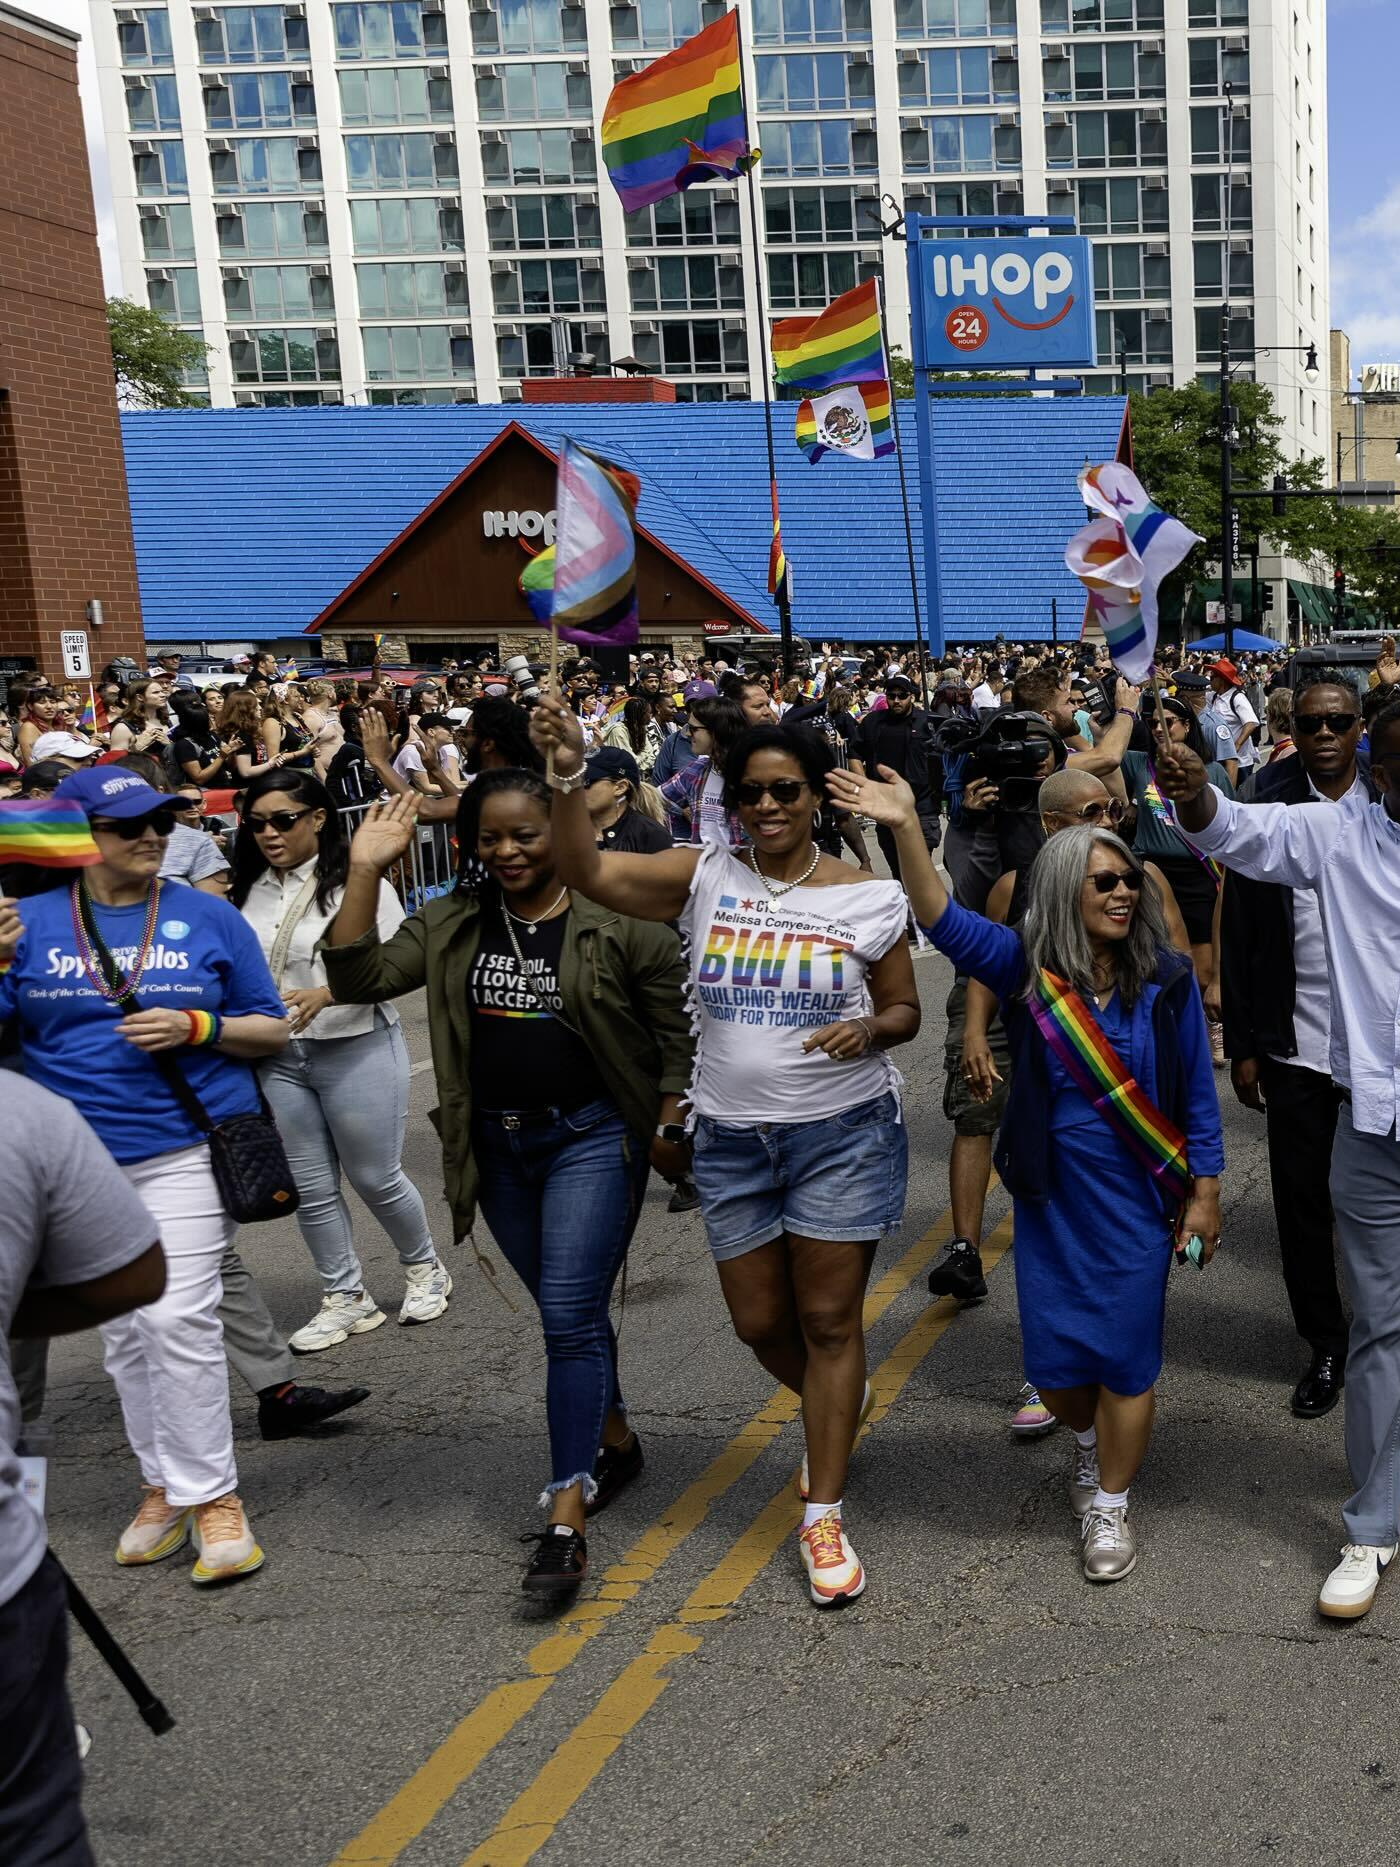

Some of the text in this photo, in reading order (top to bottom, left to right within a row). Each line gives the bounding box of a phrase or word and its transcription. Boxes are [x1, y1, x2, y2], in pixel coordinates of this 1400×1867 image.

[933, 251, 1073, 310] IHOP
[952, 318, 982, 338] 24
[704, 622, 730, 632] Welcome
[64, 635, 84, 644] SPEED
[66, 644, 84, 653] LIMIT
[73, 656, 81, 672] 5
[714, 910, 761, 926] Melissa
[779, 908, 806, 917] Chicago
[477, 953, 487, 967] I
[486, 954, 516, 971] SEE
[472, 969, 479, 985] I
[483, 970, 527, 991] LOVE
[28, 989, 48, 998] Clerk
[50, 988, 60, 999] of
[60, 988, 74, 997] the
[138, 985, 149, 995] of
[151, 984, 171, 993] Cook
[175, 983, 204, 994] County
[472, 988, 479, 1004] I
[700, 985, 848, 1011] BUILDING WEALTH
[704, 1003, 737, 1023] TODAY
[740, 1009, 764, 1025] FOR
